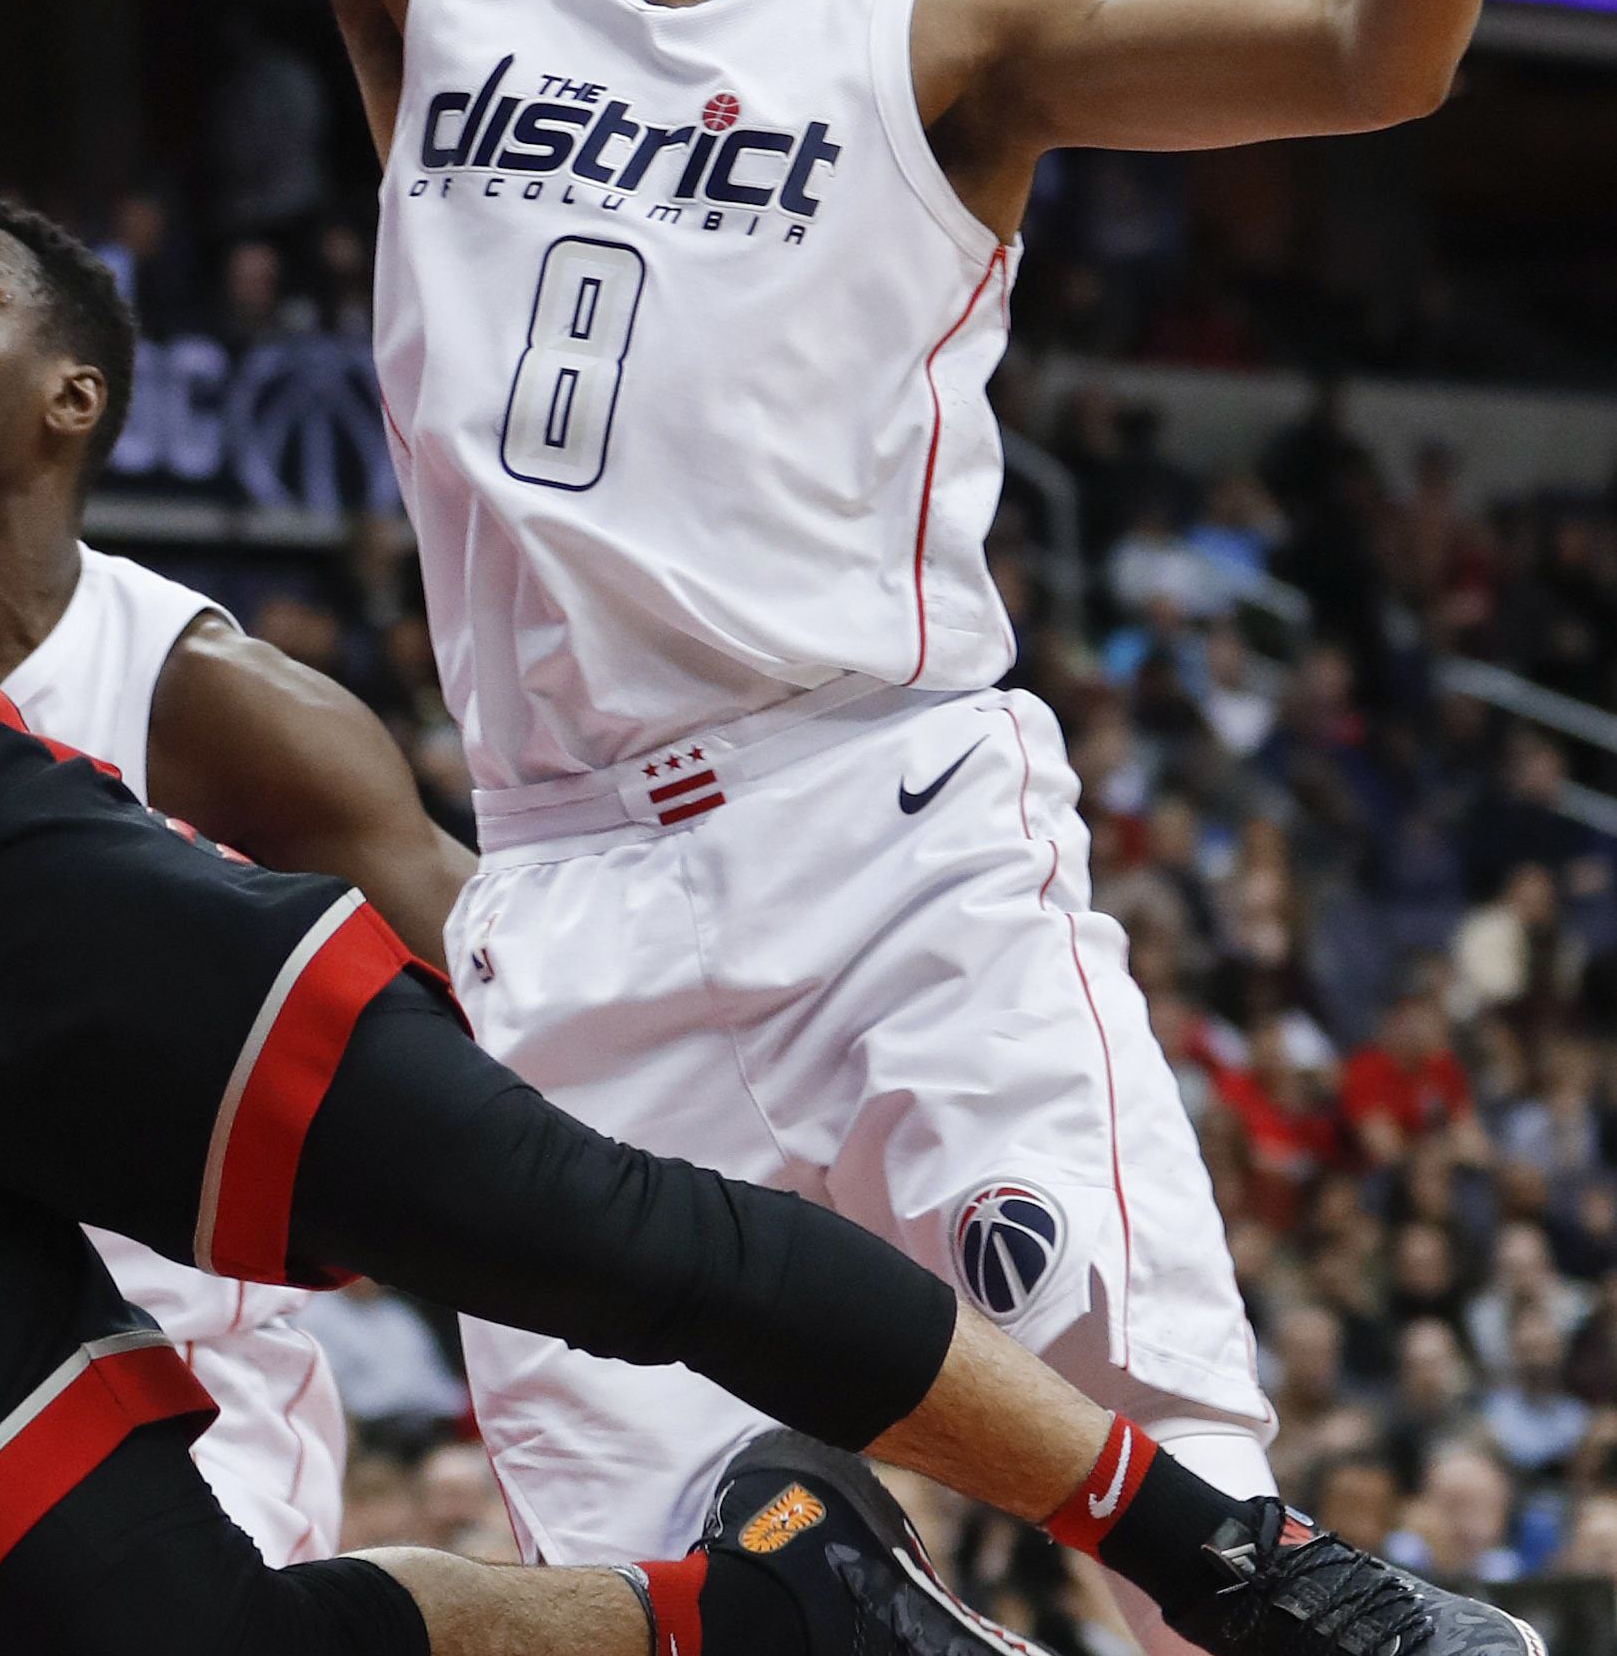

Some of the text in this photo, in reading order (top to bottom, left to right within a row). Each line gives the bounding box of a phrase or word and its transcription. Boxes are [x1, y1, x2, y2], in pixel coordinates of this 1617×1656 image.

[421, 52, 843, 219] district
[537, 74, 608, 104] THE
[409, 178, 807, 245] OF COLUMBIA
[499, 233, 649, 494] 8
